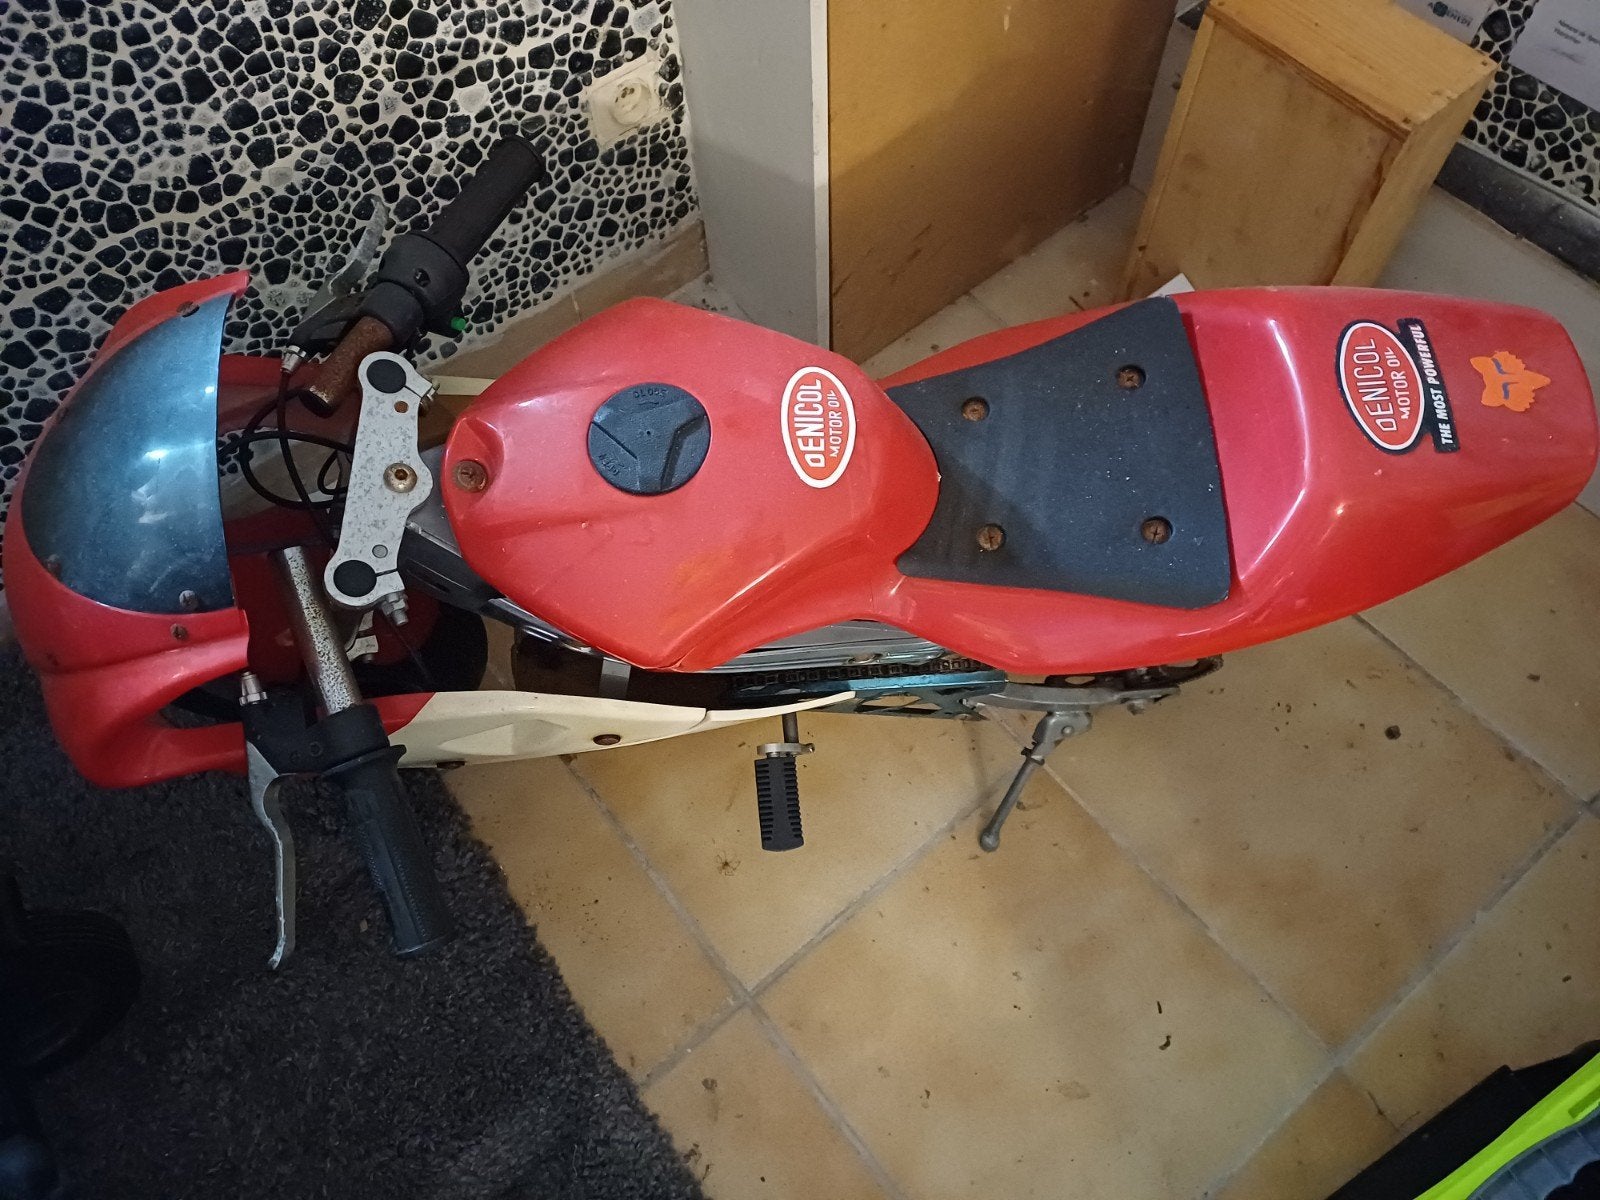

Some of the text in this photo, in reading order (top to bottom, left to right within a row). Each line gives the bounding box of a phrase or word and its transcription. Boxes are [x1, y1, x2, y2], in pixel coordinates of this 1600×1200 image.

[793, 378, 826, 468] DENICOL
[826, 389, 845, 458] MOTOR OIL
[1352, 338, 1398, 432] DENICOL
[1384, 346, 1411, 420] MOTOR OIL
[1409, 325, 1454, 445] THE MOST POWERFUL
